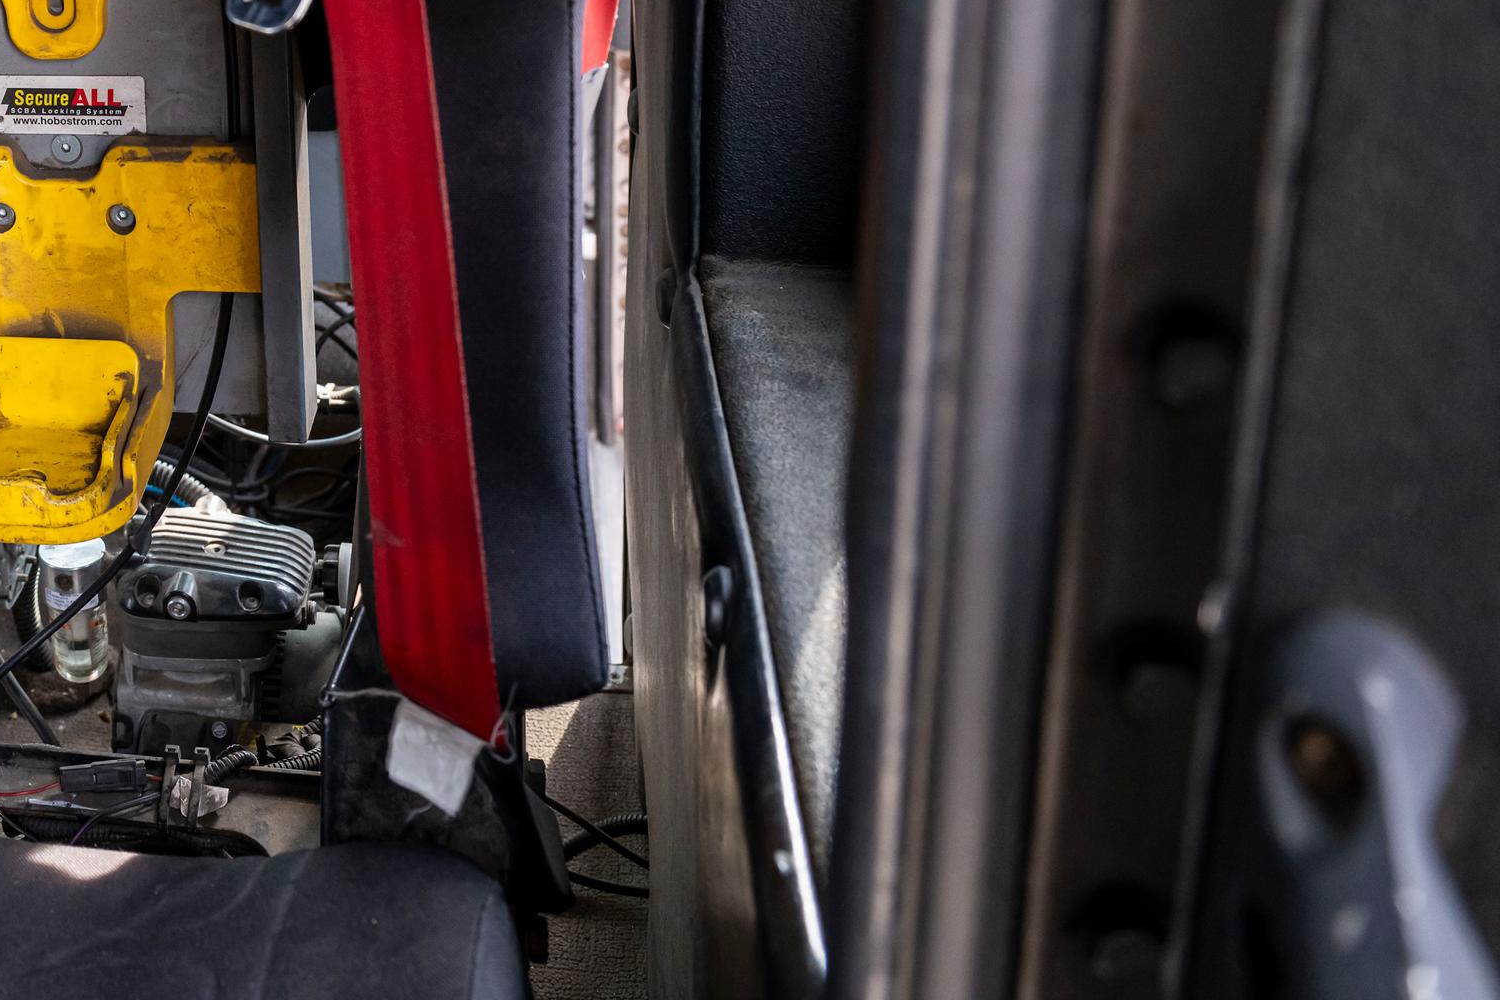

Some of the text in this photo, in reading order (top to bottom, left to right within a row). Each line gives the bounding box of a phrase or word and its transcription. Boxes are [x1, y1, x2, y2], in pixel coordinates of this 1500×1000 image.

[42, 107, 81, 115] Locking
[86, 107, 122, 115] System
[13, 116, 122, 126] www.hobostrom.com
